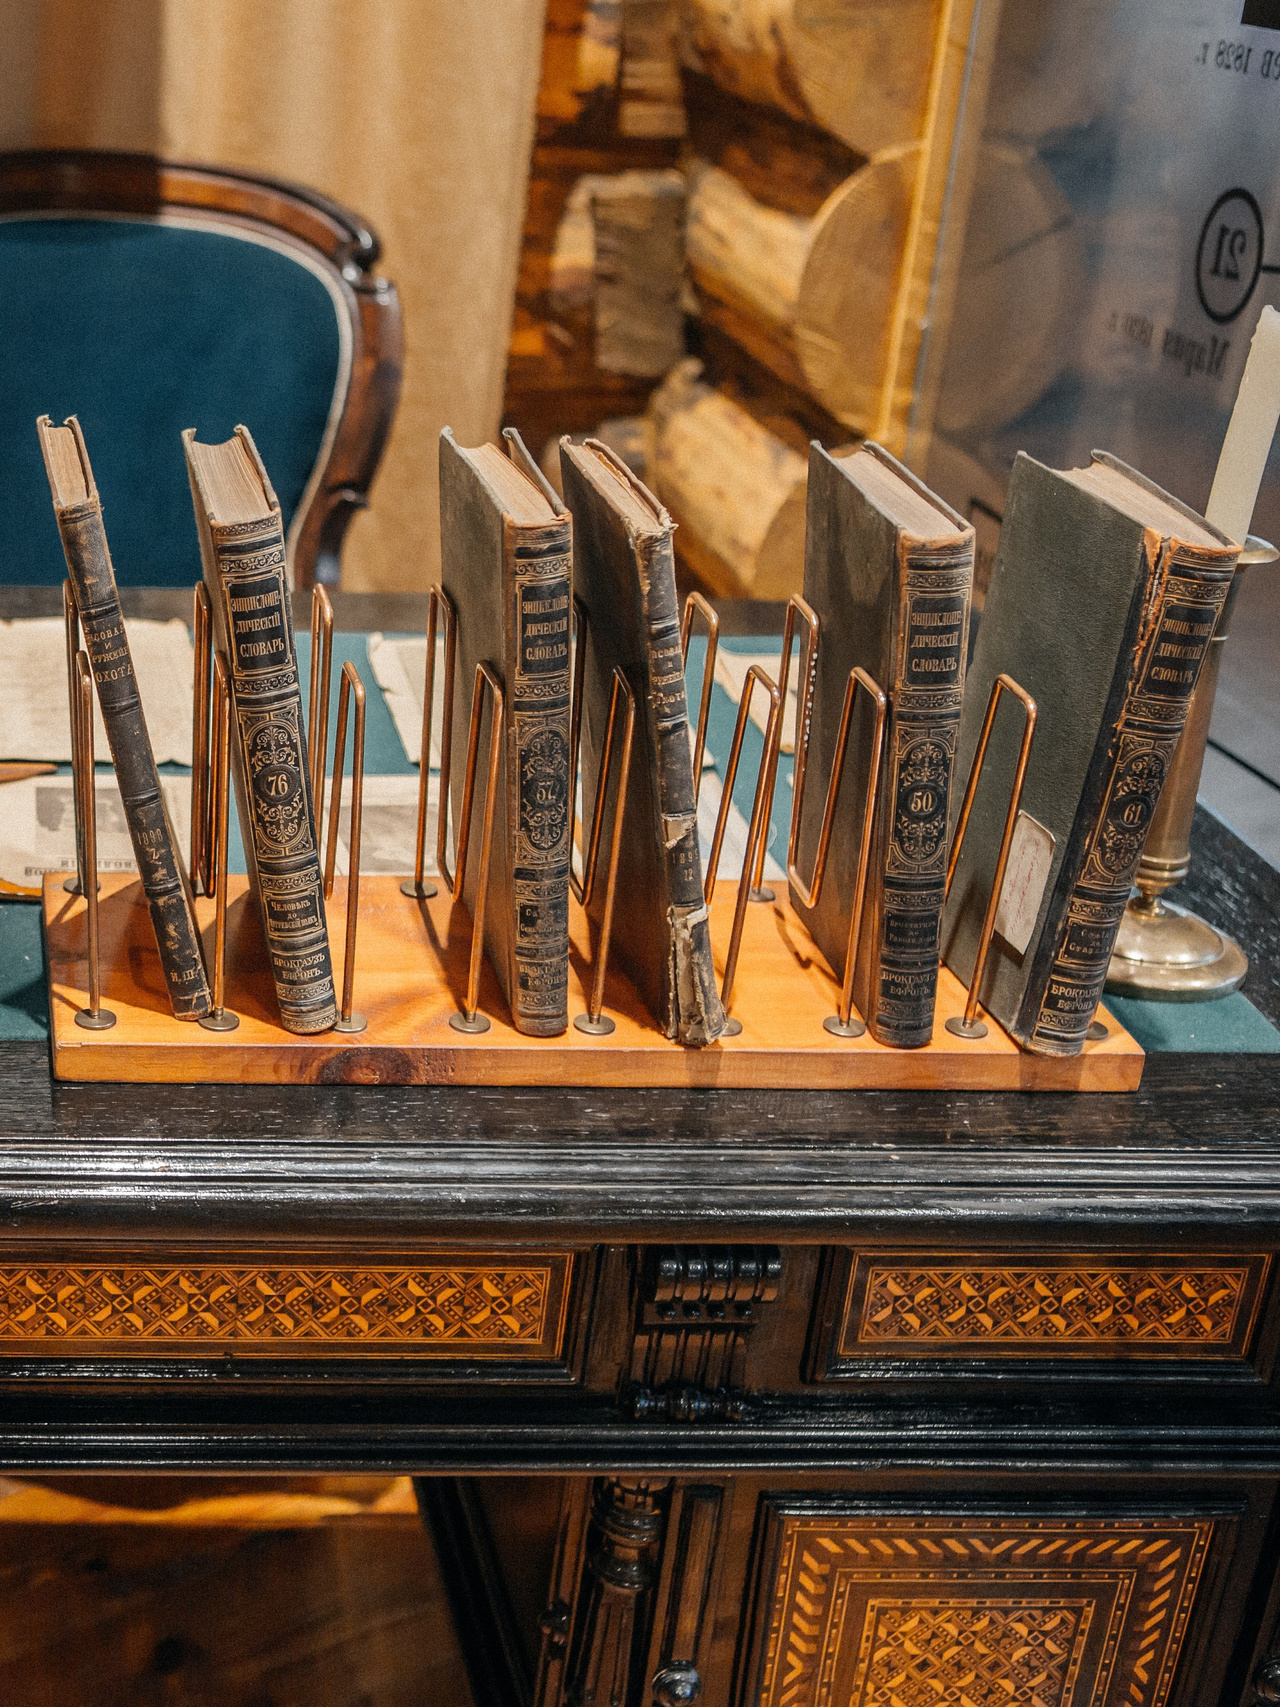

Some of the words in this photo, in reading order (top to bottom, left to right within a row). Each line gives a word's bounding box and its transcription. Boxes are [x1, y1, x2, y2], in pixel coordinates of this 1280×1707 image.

[240, 638, 285, 658] СЛОВАРЬ
[526, 642, 568, 661] СЛОВАРЬ
[912, 656, 958, 673] СЛОВАРЬ
[1151, 666, 1193, 683] СЛОВАРЬ
[268, 773, 289, 796] 76
[1123, 803, 1142, 823] 61
[273, 952, 326, 968] БРОКГАУЗЪ
